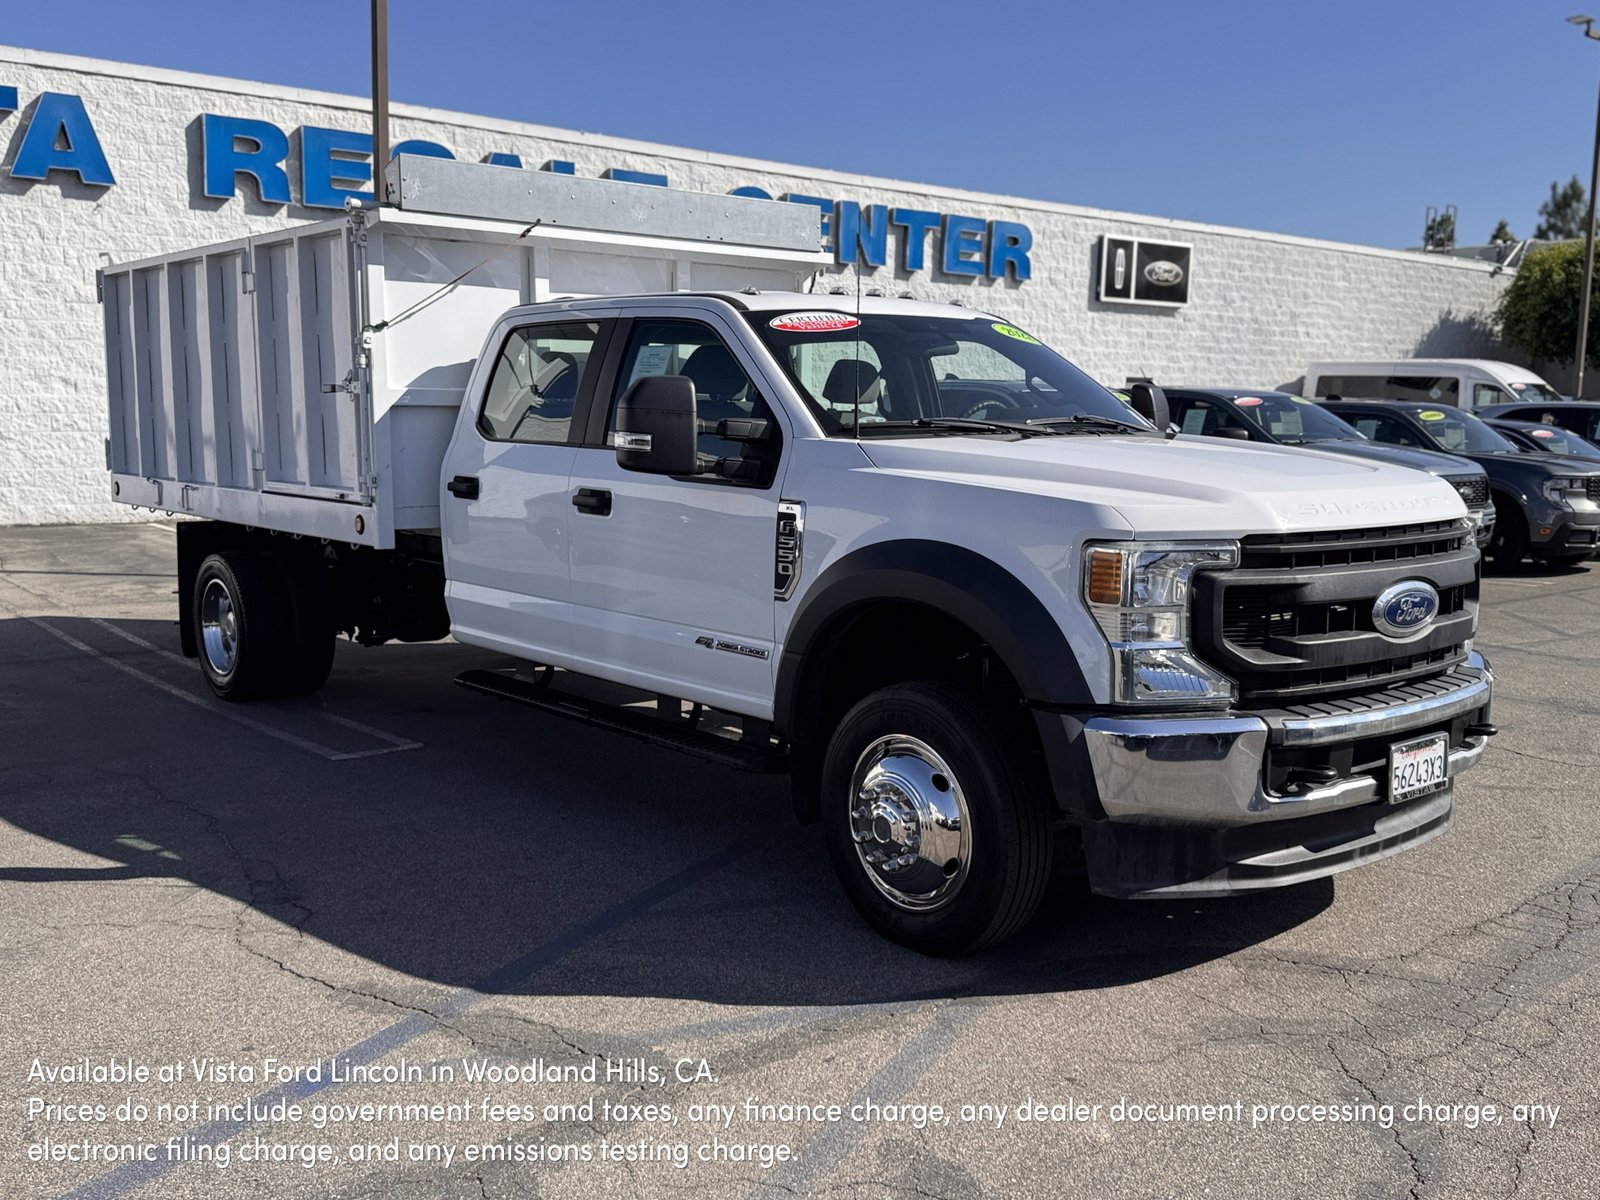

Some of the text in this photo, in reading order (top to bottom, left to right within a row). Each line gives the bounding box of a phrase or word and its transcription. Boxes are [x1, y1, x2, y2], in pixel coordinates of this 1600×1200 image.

[1395, 596, 1428, 623] Ford
[1393, 754, 1444, 792] 56243X3
[1406, 785, 1431, 799] VISTA
